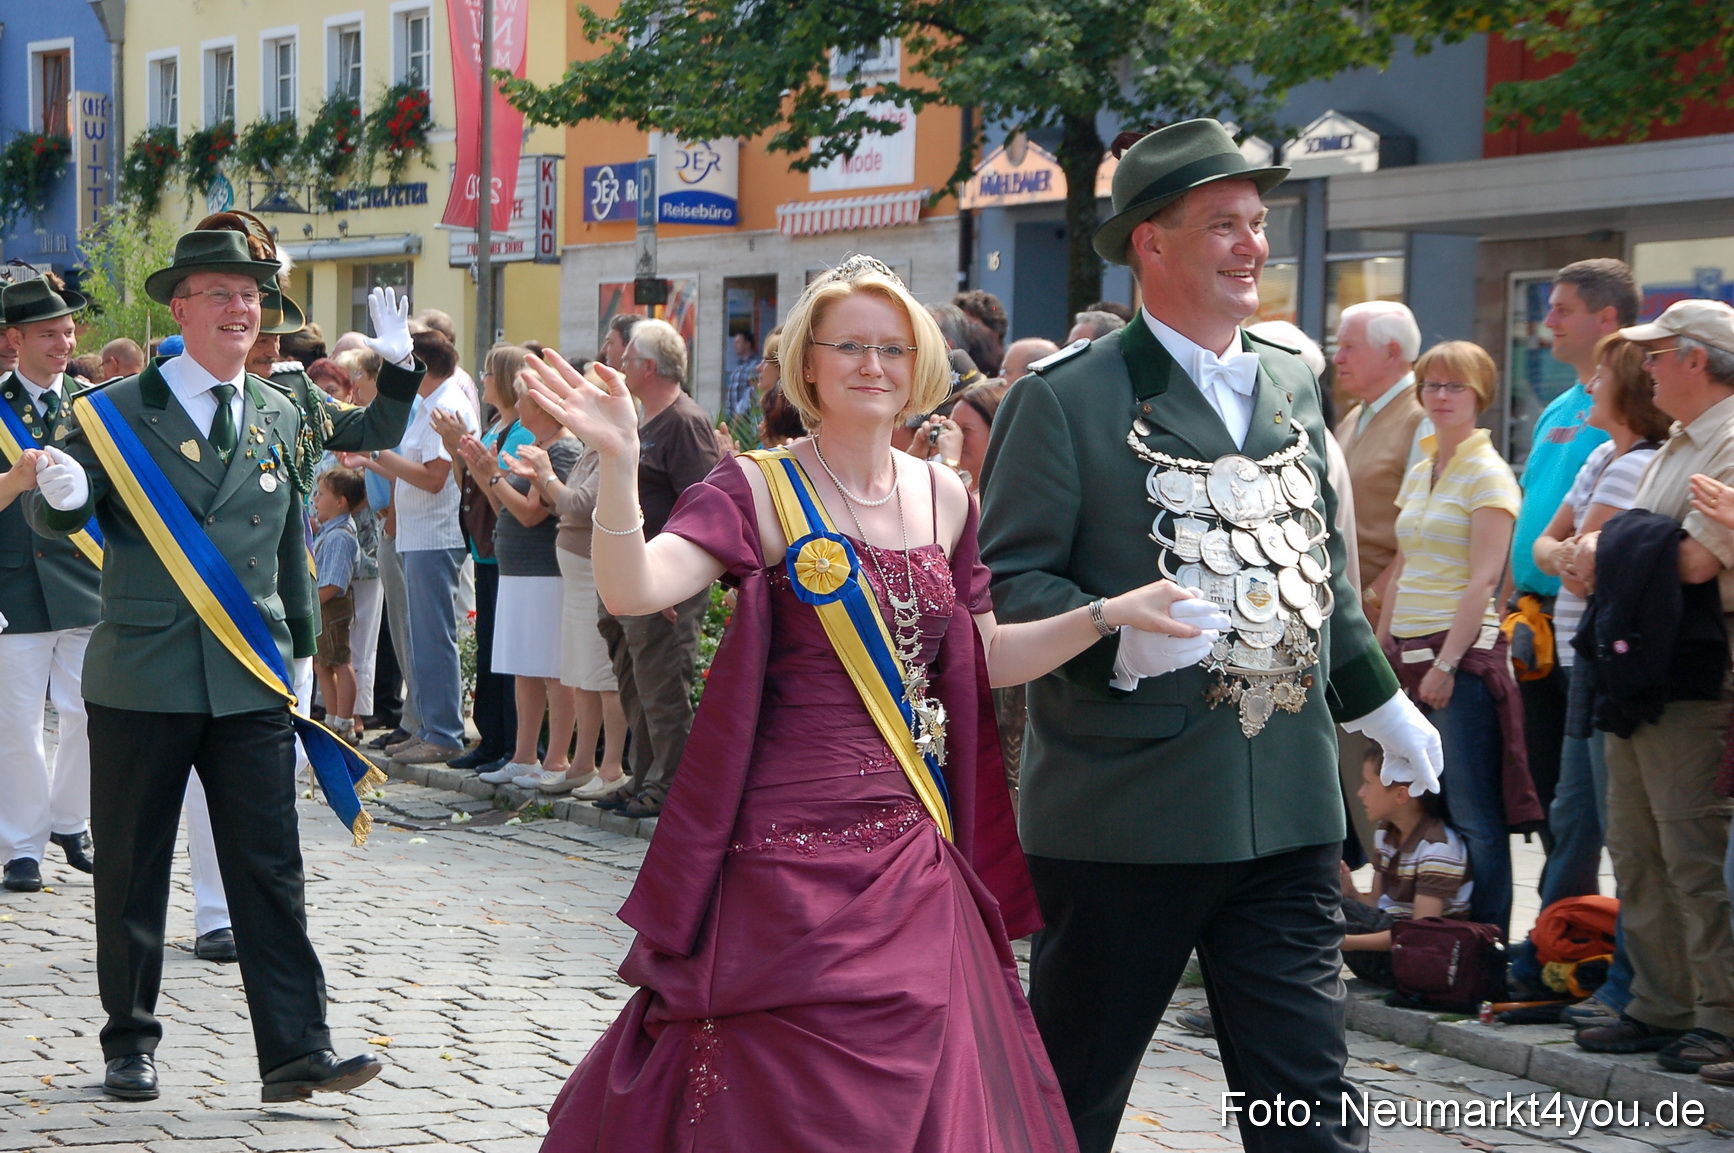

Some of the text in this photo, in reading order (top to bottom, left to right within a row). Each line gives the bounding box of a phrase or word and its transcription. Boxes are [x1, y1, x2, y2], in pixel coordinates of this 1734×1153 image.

[676, 149, 722, 174] DER
[841, 148, 883, 174] Mode
[541, 160, 553, 254] KINO
[591, 176, 620, 209] DER
[641, 168, 652, 218] P
[663, 202, 733, 221] Reisebüro
